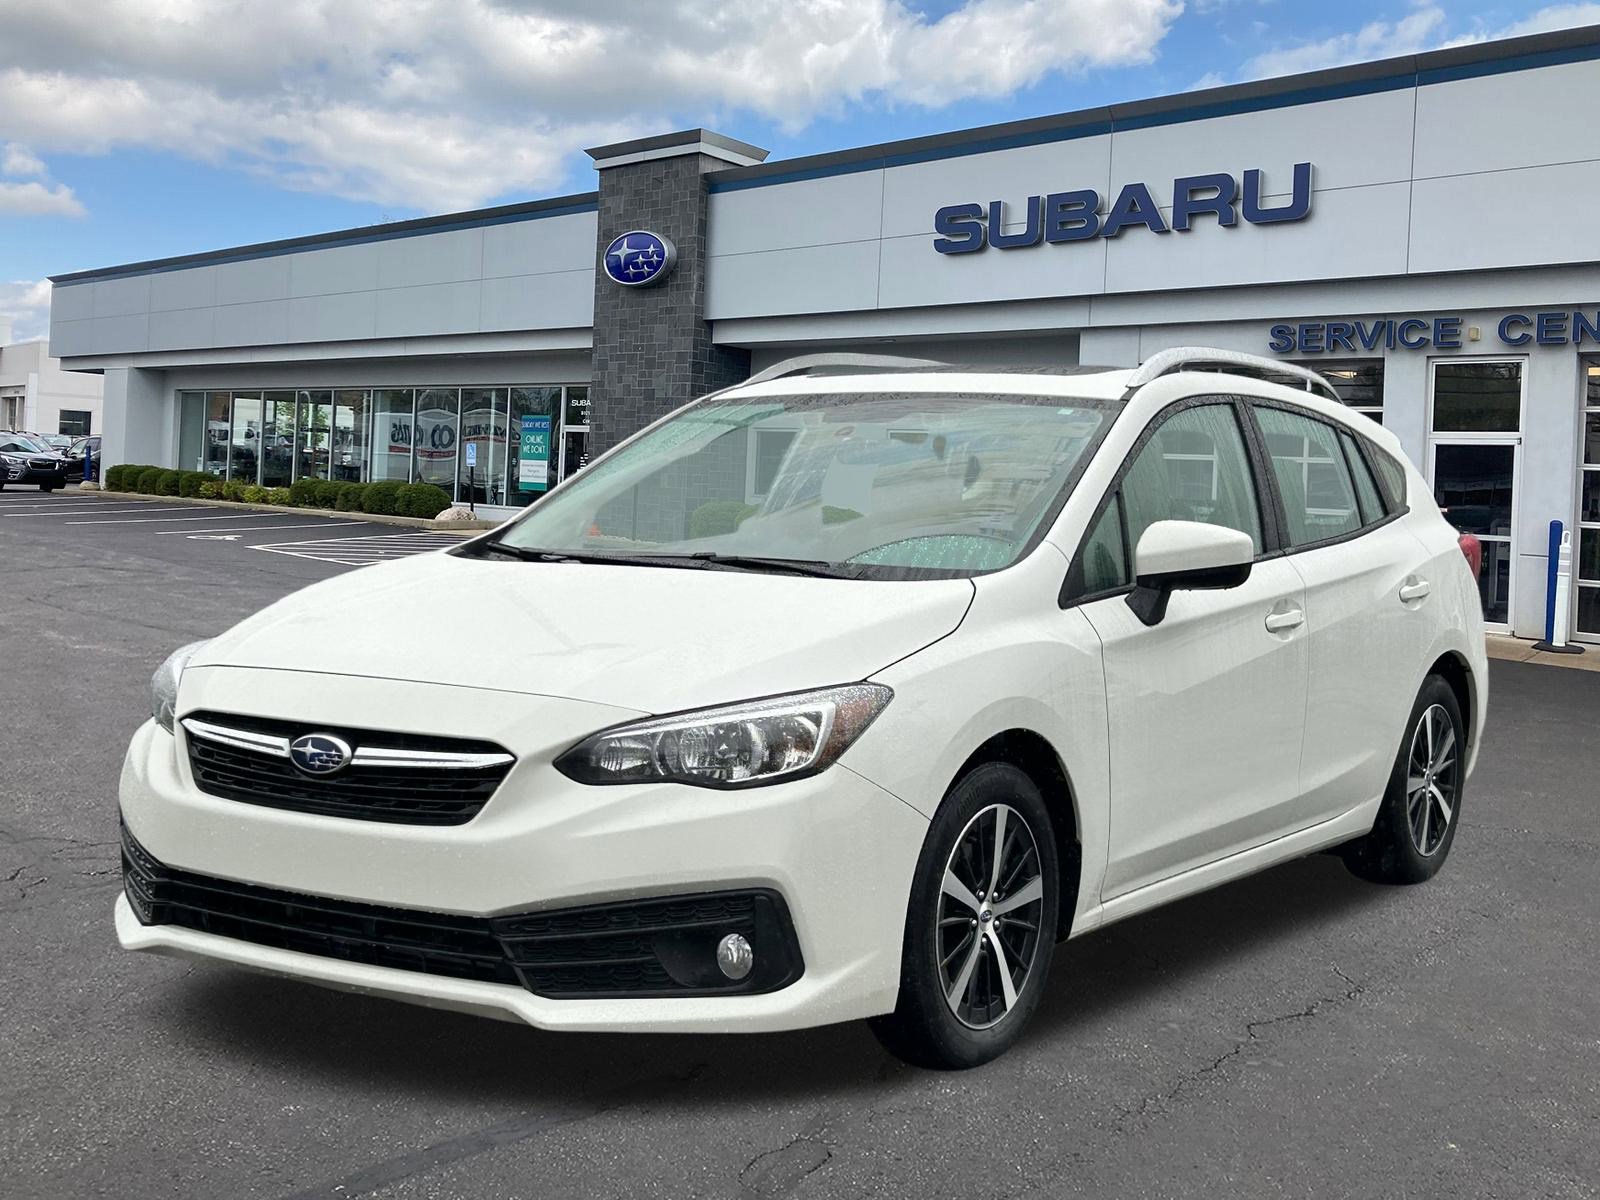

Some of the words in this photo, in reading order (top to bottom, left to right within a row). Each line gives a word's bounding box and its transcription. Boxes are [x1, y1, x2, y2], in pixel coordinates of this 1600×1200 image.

[933, 161, 1314, 255] SUBARU
[1268, 316, 1463, 353] SERVICE
[1497, 310, 1600, 345] CEN
